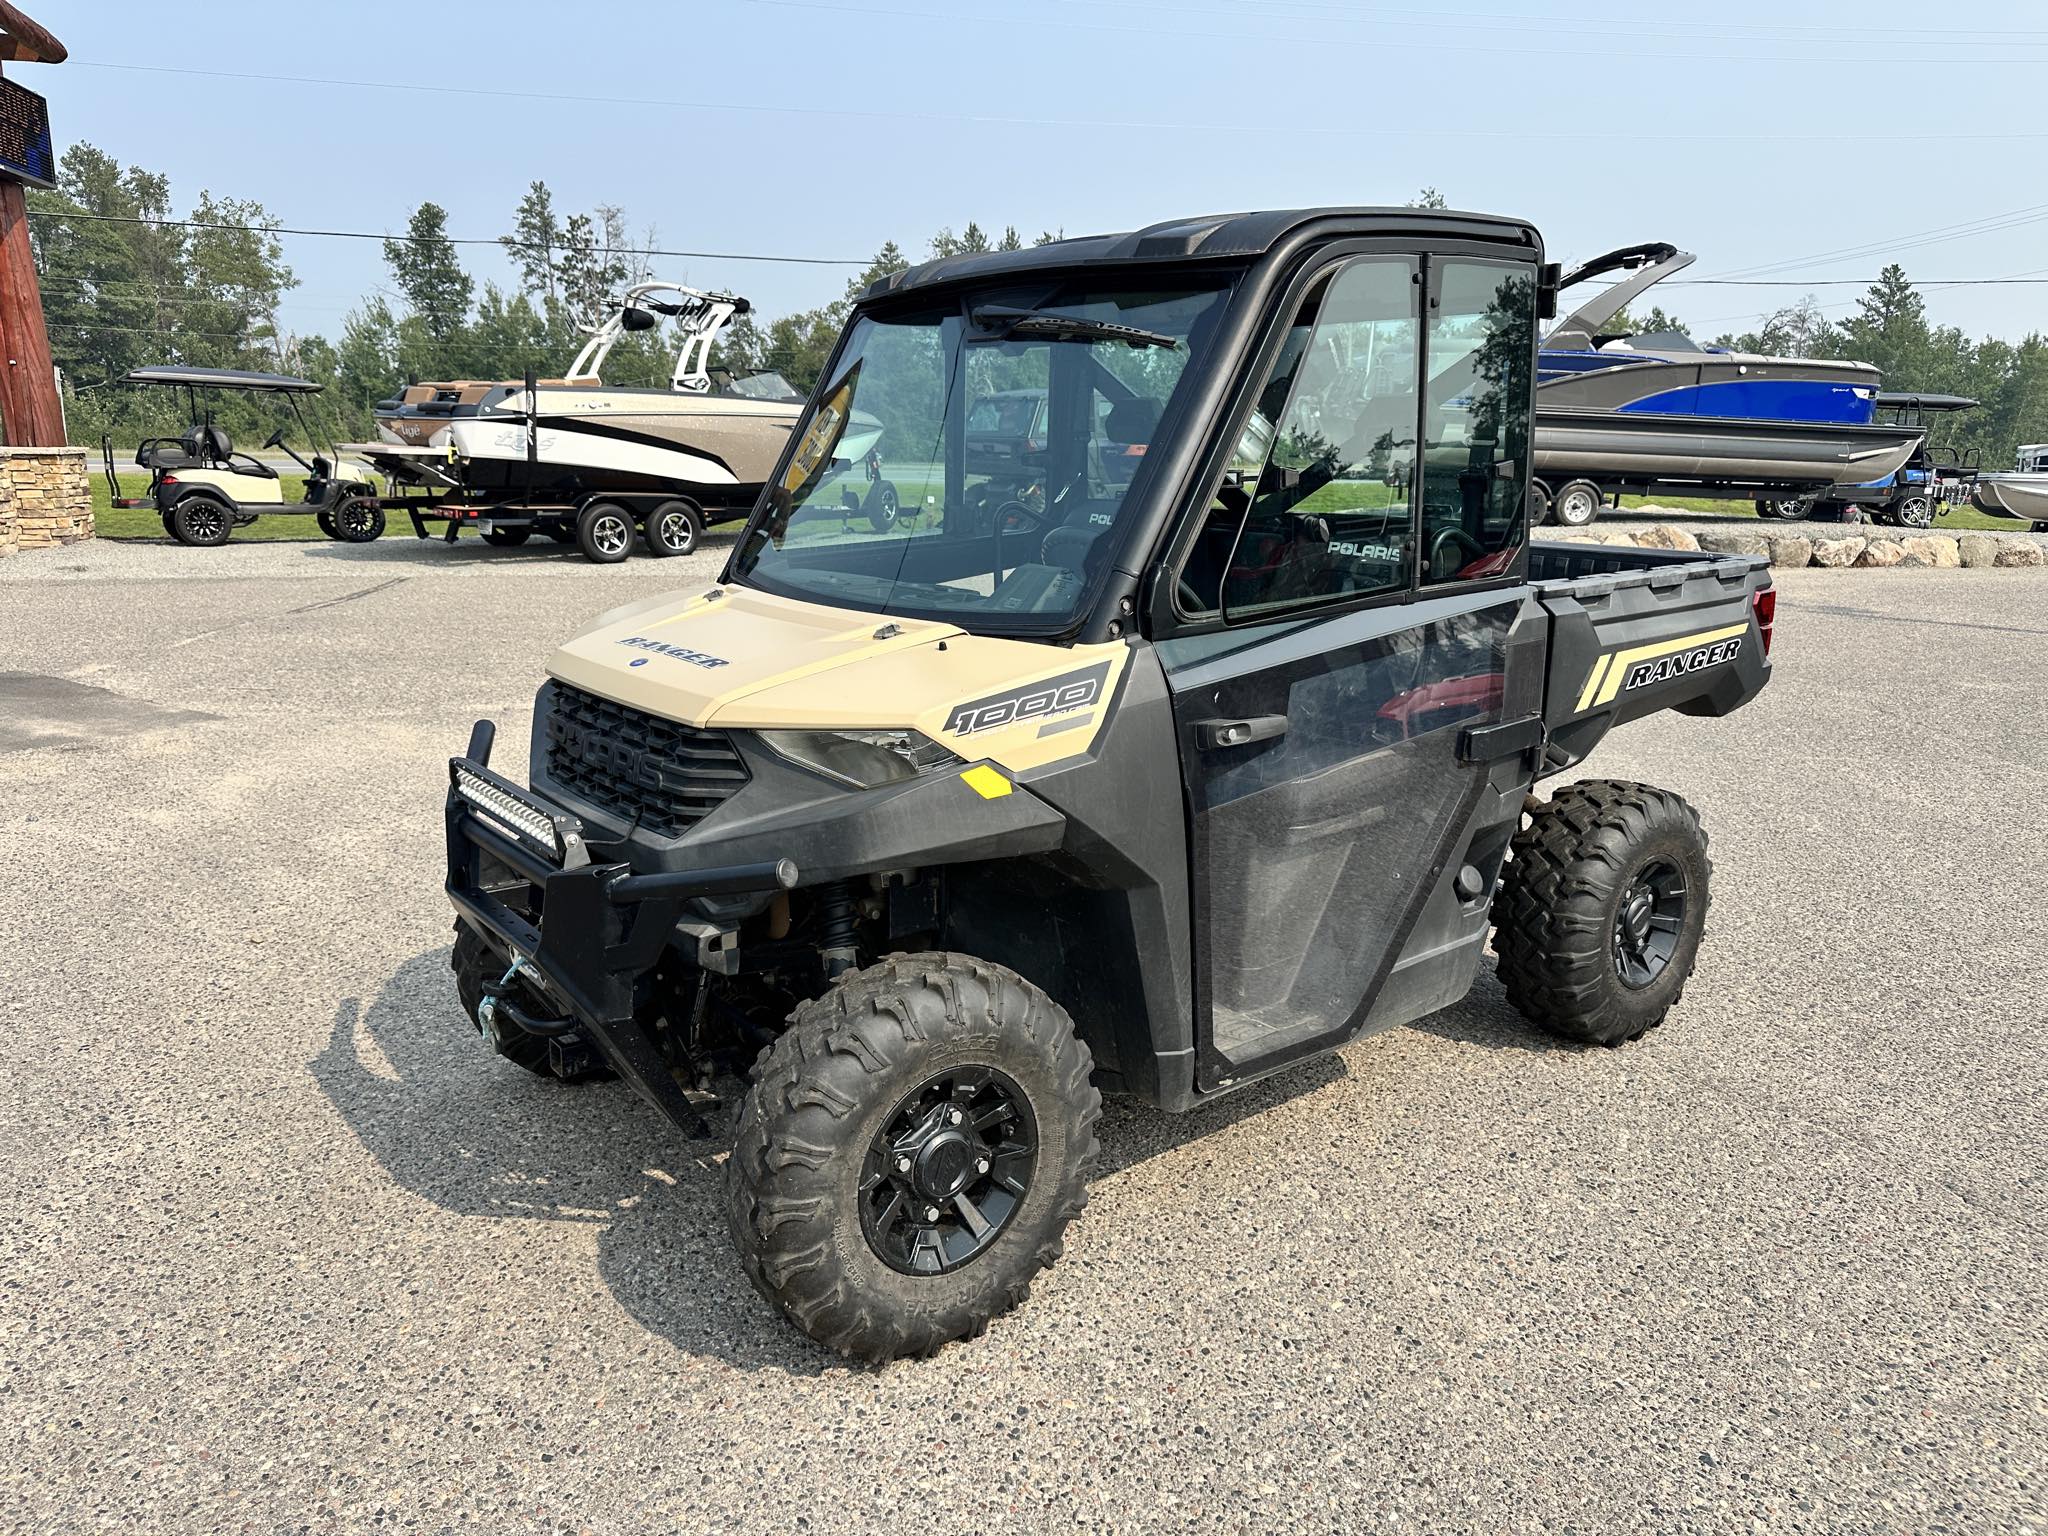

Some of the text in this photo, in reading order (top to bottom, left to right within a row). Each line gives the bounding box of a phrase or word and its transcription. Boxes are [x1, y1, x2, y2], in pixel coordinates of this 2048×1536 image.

[1327, 541, 1400, 562] POLARIS
[615, 637, 731, 669] RANGER
[1625, 638, 1742, 691] RANGER
[953, 678, 1098, 738] 1000
[546, 711, 664, 793] POLARIS
